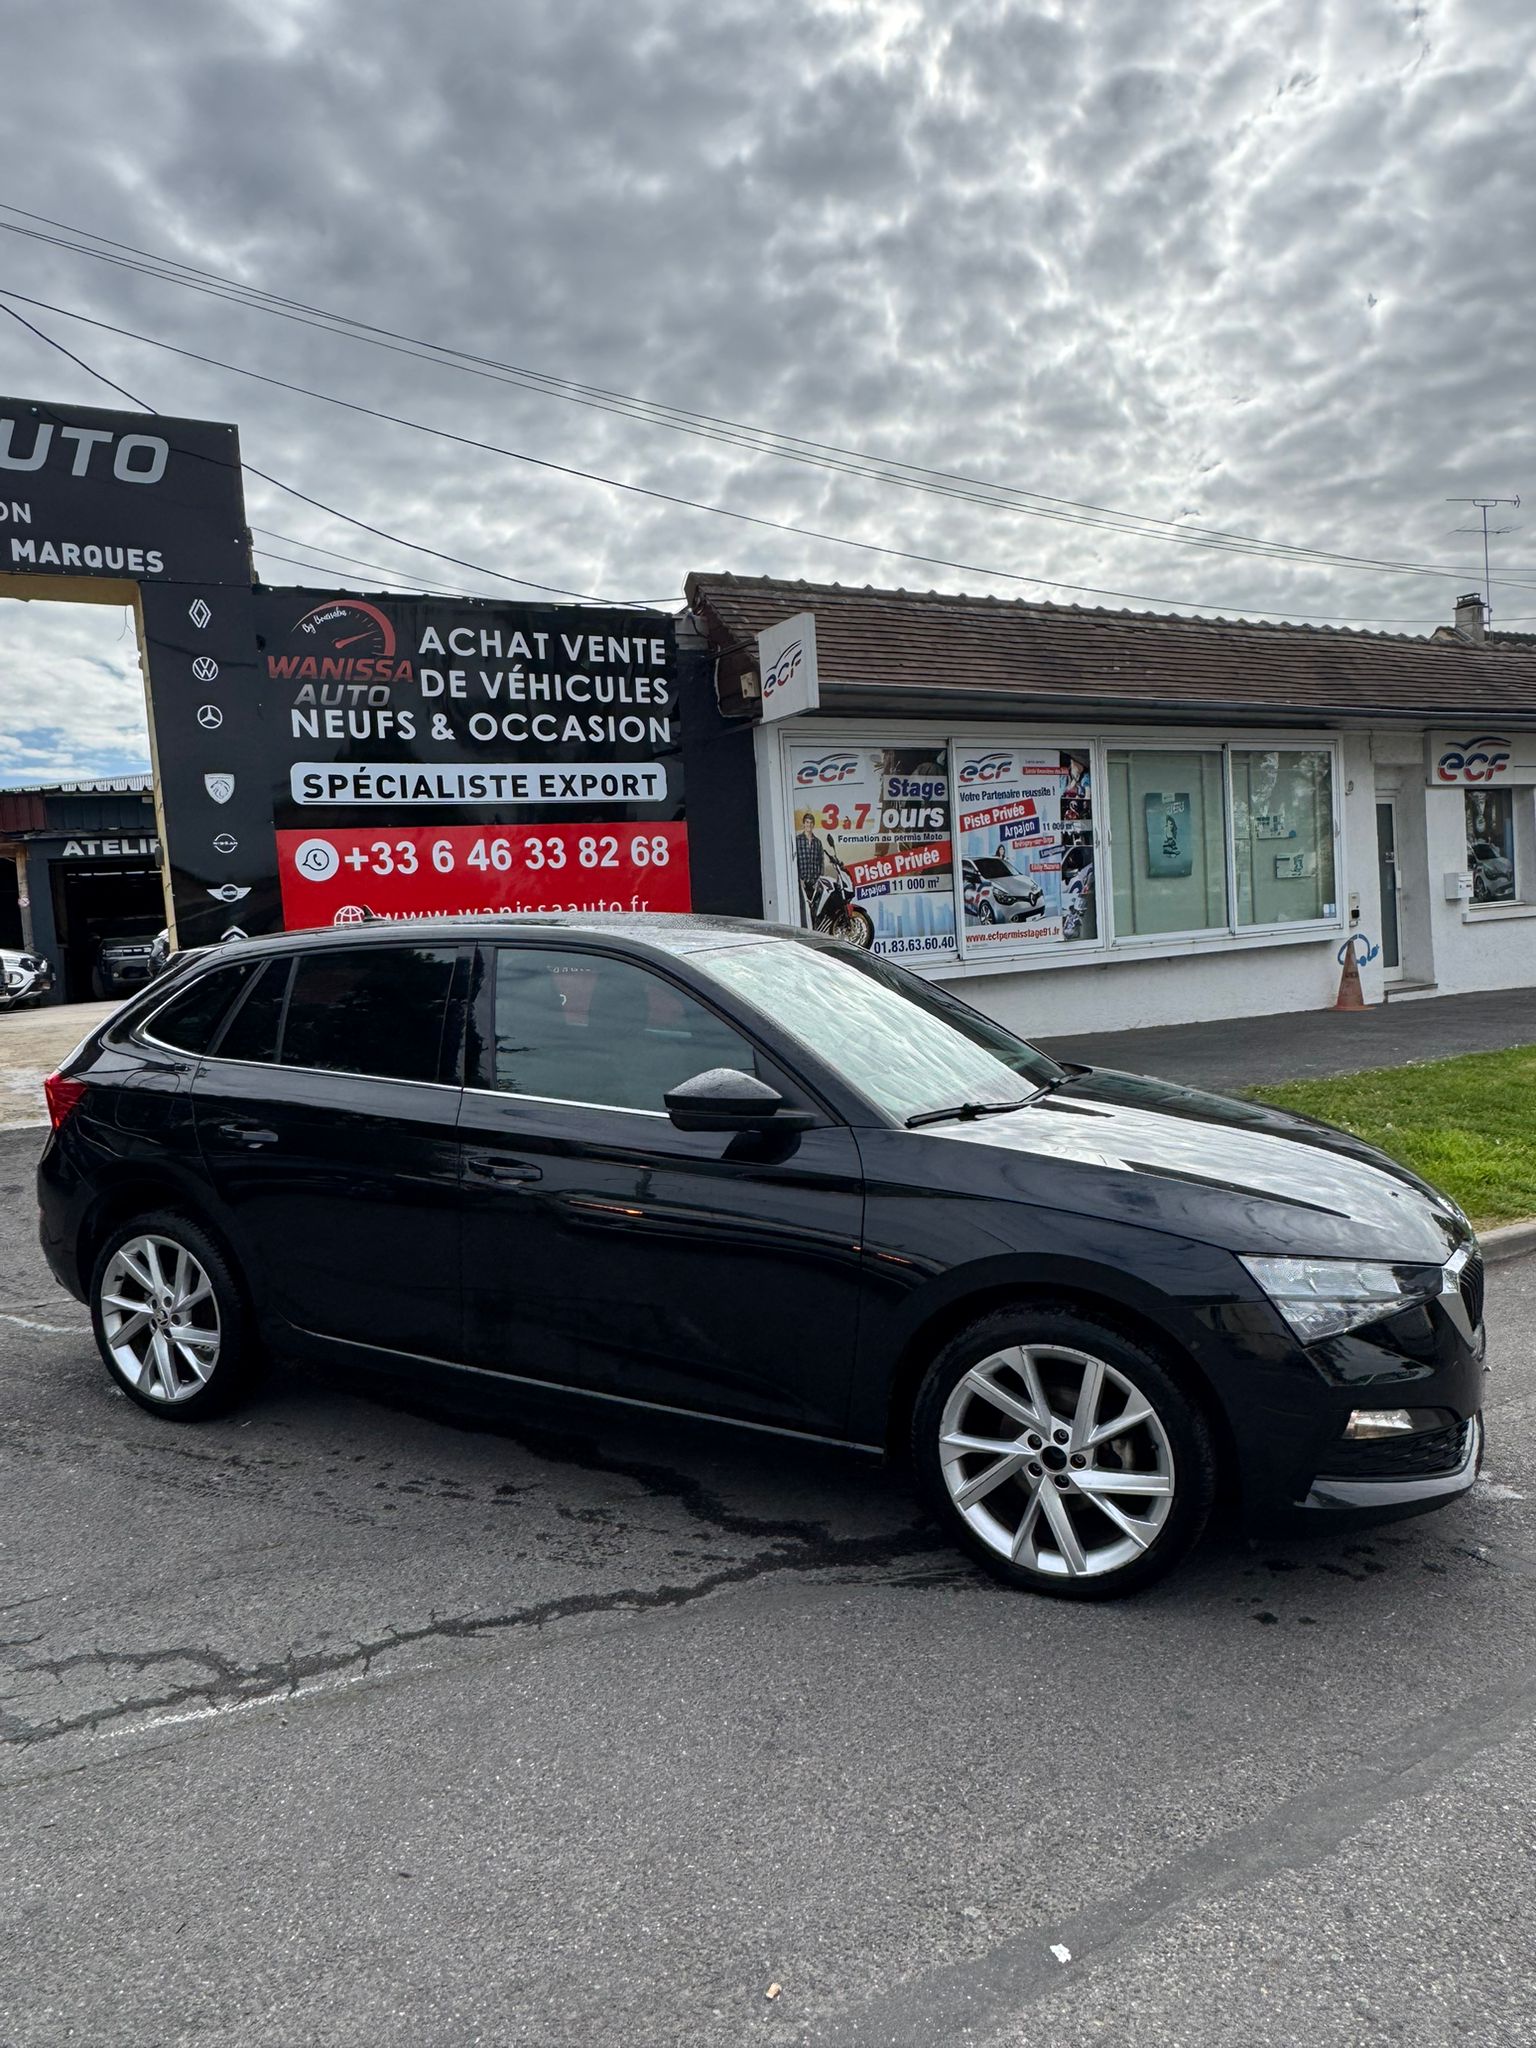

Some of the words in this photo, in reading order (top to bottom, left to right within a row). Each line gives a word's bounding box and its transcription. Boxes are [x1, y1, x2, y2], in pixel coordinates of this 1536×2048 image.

[11, 538, 164, 573] MARQUES
[418, 626, 549, 660] ACHAT
[560, 633, 666, 665] VENTE
[267, 655, 414, 683] WANISSA
[293, 683, 391, 707] AUTO
[420, 669, 467, 698] DE
[479, 664, 669, 705] VÉHICULES
[290, 708, 416, 740] NEUFS
[431, 713, 456, 740] &
[468, 712, 671, 743] OCCASION
[303, 767, 529, 800] SPÉCIALISTE
[540, 774, 657, 797] EXPORT
[888, 778, 945, 800] Stage
[960, 791, 980, 802] Votre
[982, 788, 1020, 800] Partenaire
[821, 803, 839, 830] 3
[855, 803, 871, 829] 7
[964, 813, 990, 830] Piste
[992, 804, 1025, 822] Privée
[1005, 821, 1035, 838] Arpajon
[838, 834, 879, 843] Formation
[894, 833, 921, 843] permis
[923, 832, 943, 841] Moto
[345, 841, 419, 875] +33
[432, 840, 455, 873] 6
[467, 838, 513, 870] 46
[524, 837, 567, 870] 33
[579, 836, 619, 867] 82
[631, 835, 669, 866] 68
[854, 861, 893, 884] Piste
[895, 847, 940, 873] Privée
[860, 884, 886, 898] Arpajon
[892, 880, 903, 891] 11
[907, 878, 925, 890] 000
[874, 936, 955, 955] 01.83.63.60.40
